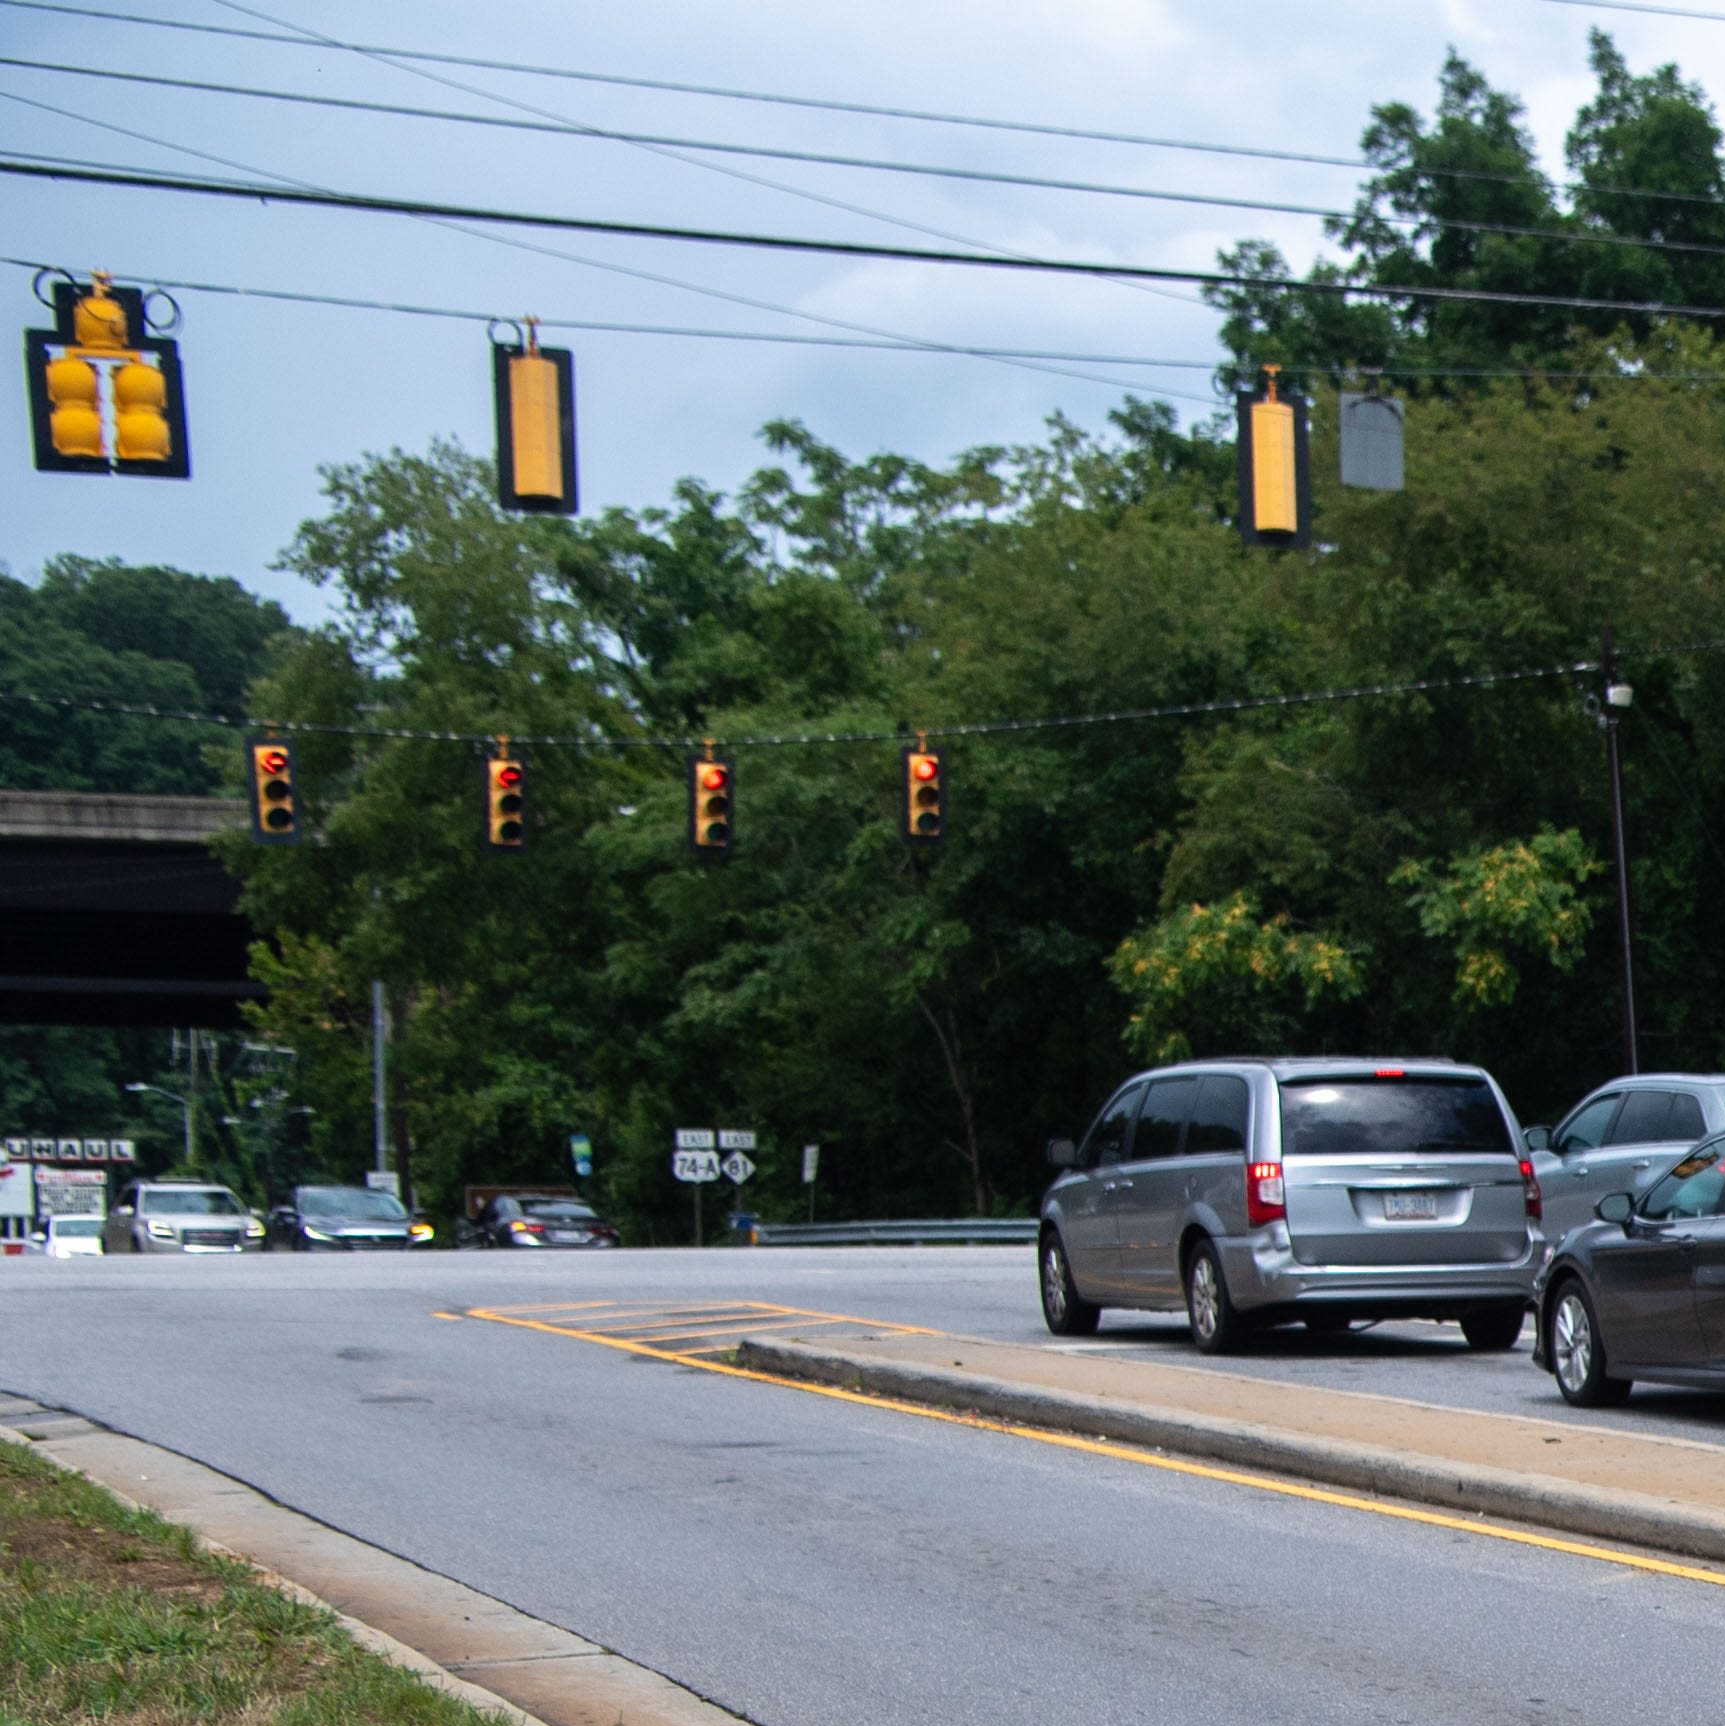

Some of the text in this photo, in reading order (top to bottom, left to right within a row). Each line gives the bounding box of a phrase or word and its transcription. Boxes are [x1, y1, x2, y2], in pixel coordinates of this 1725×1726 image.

[682, 1134, 710, 1145] EAST
[725, 1135, 751, 1146] EAST
[678, 1158, 718, 1177] 74-A
[728, 1160, 749, 1176] 81
